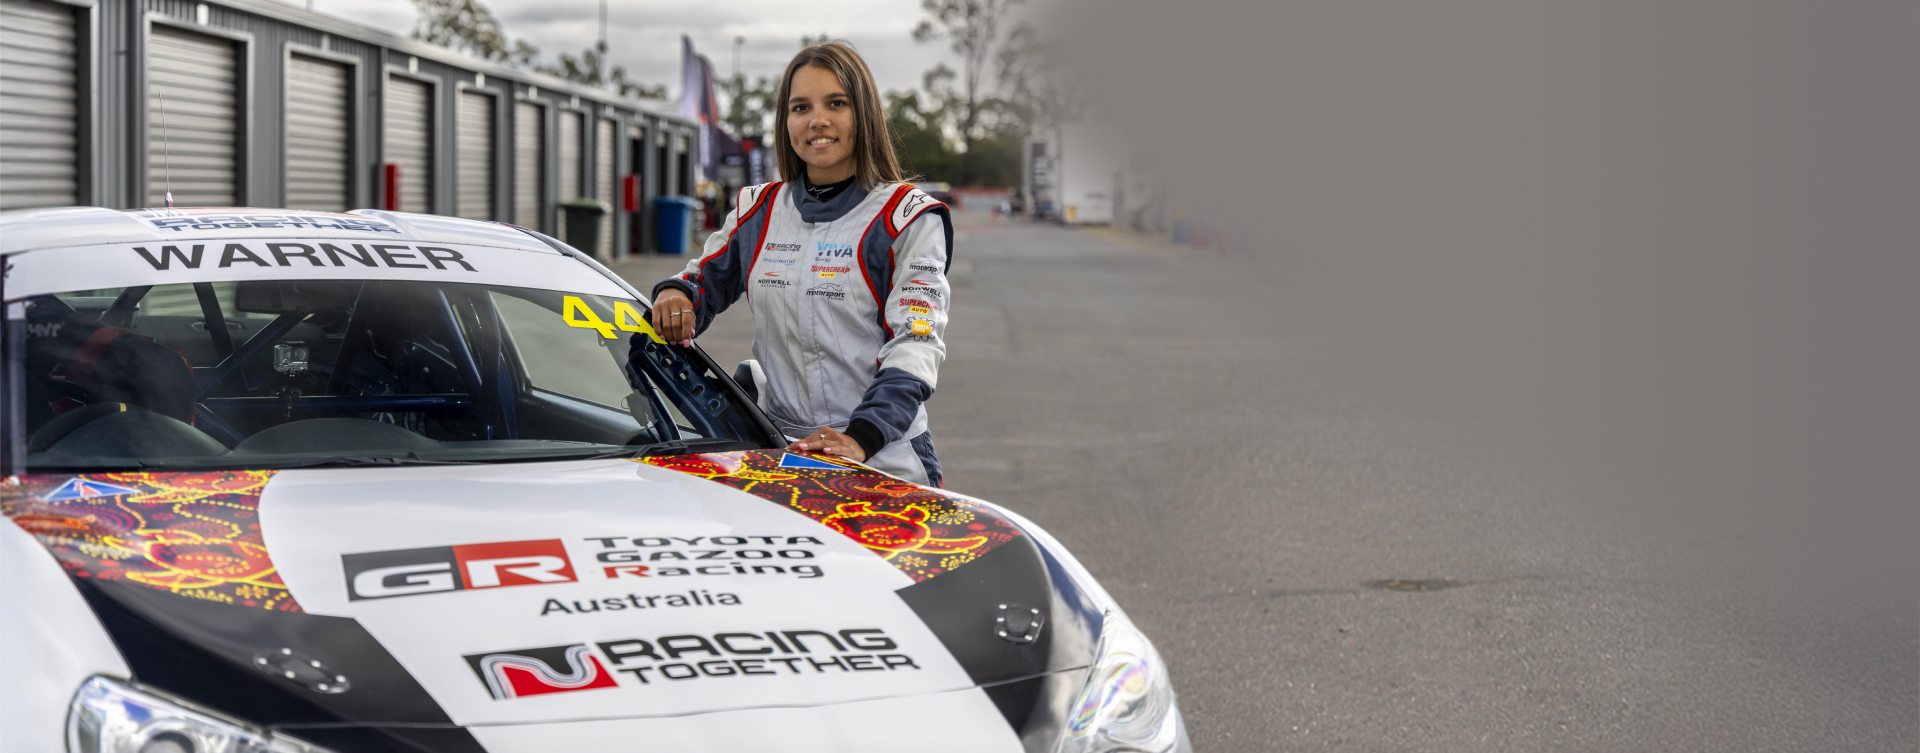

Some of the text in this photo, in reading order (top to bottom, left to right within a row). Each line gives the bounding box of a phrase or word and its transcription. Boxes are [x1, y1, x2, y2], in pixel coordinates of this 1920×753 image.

[158, 221, 402, 235] TOGETHER
[132, 242, 479, 273] WARNER
[817, 242, 853, 258] VIVA
[810, 264, 851, 274] SUPERCHEAP
[805, 290, 846, 299] motorsport
[901, 286, 942, 298] NORWELL
[562, 295, 669, 346] 44
[584, 536, 825, 549] TOYOTA
[595, 549, 816, 563] GAZOO
[353, 554, 573, 599] GR
[602, 562, 826, 579] Racing
[539, 590, 743, 616] Australia
[594, 628, 899, 666] RACING
[616, 654, 922, 685] TOGETHER
